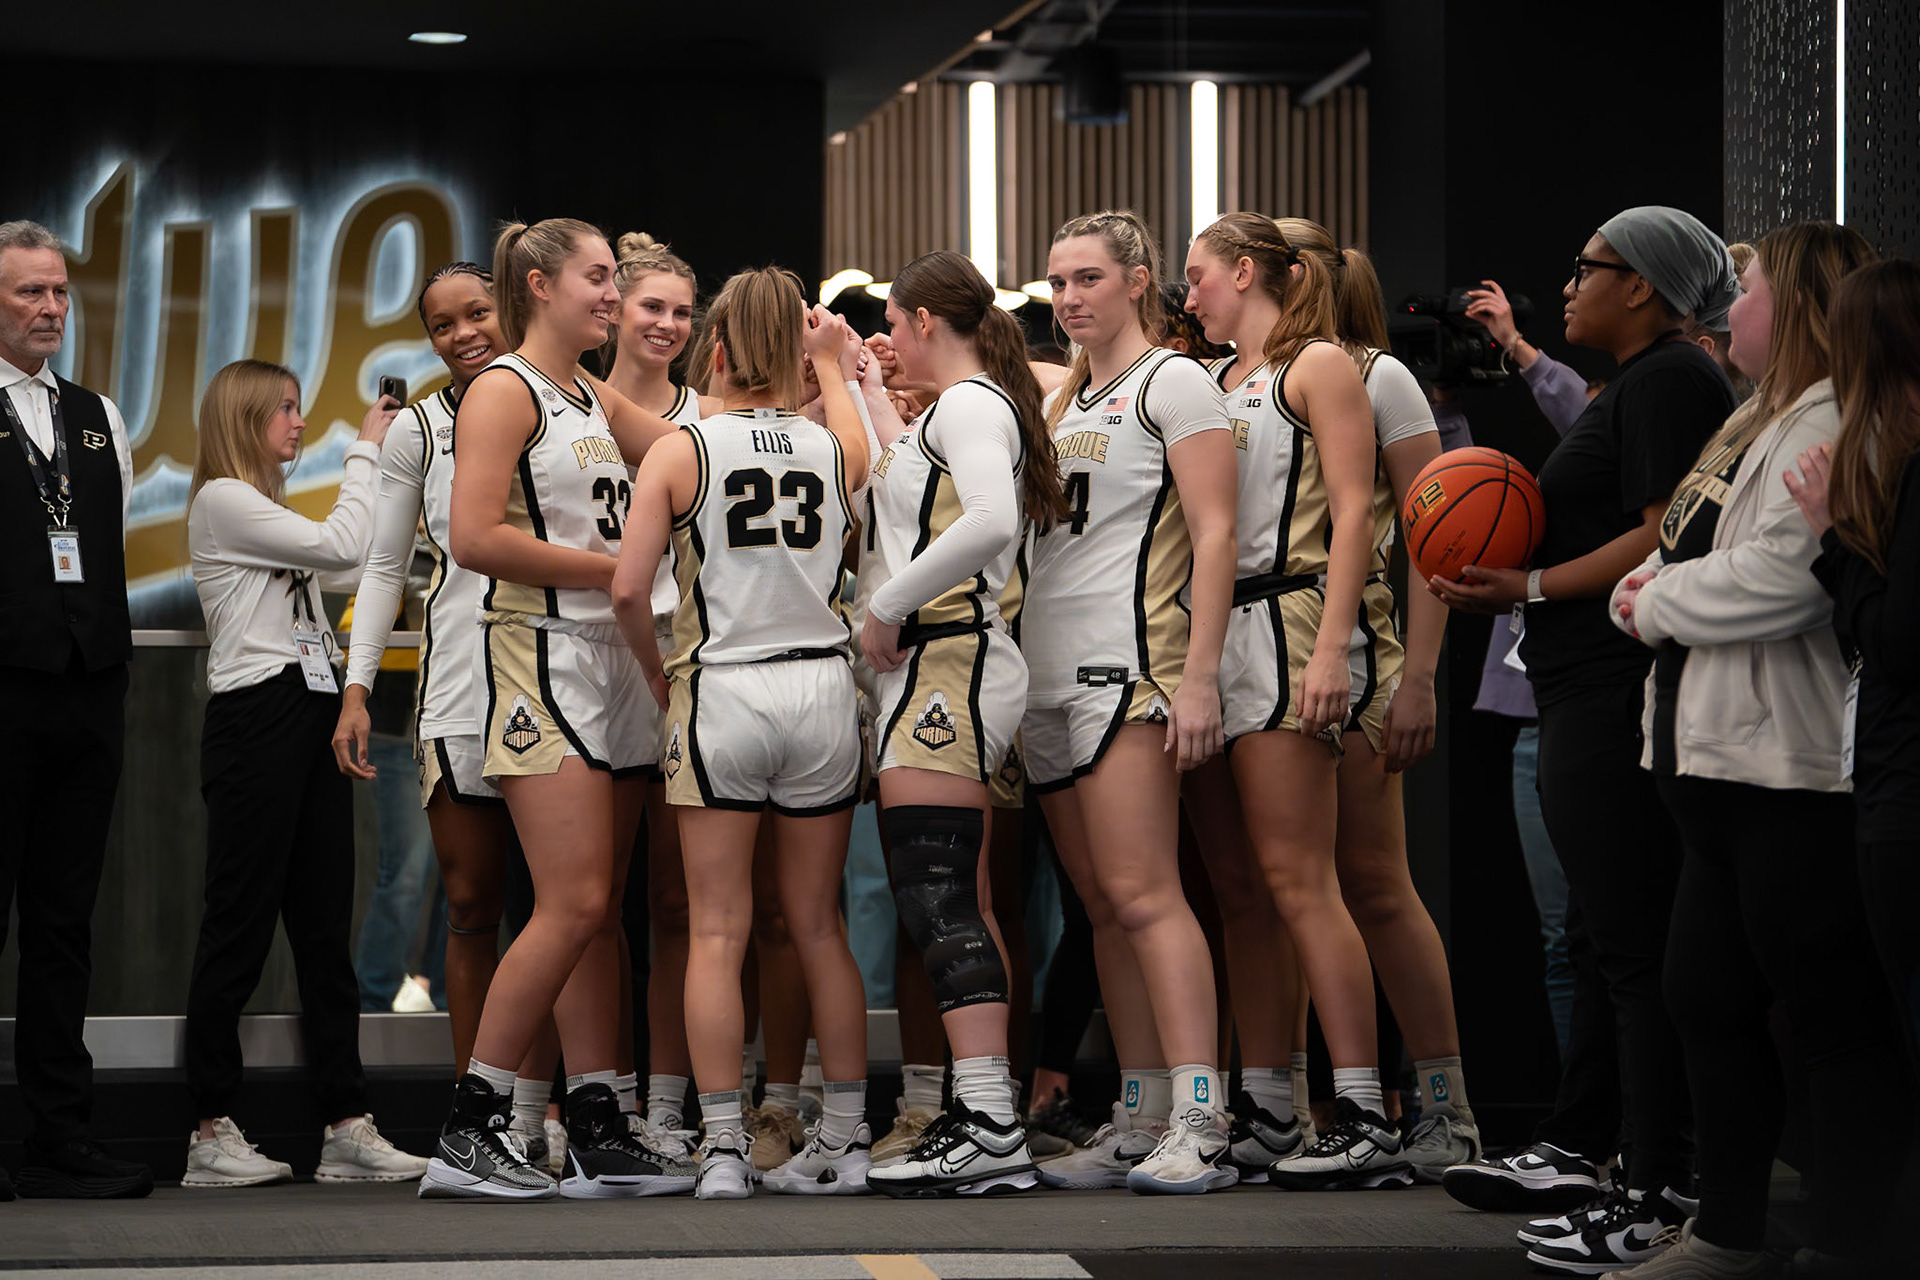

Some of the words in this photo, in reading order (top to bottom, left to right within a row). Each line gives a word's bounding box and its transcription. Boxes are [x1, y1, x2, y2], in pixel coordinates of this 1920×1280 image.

[752, 430, 793, 455] ELLIS
[724, 467, 824, 552] 23
[504, 730, 539, 749] PURDUE
[915, 726, 954, 745] PURDUE
